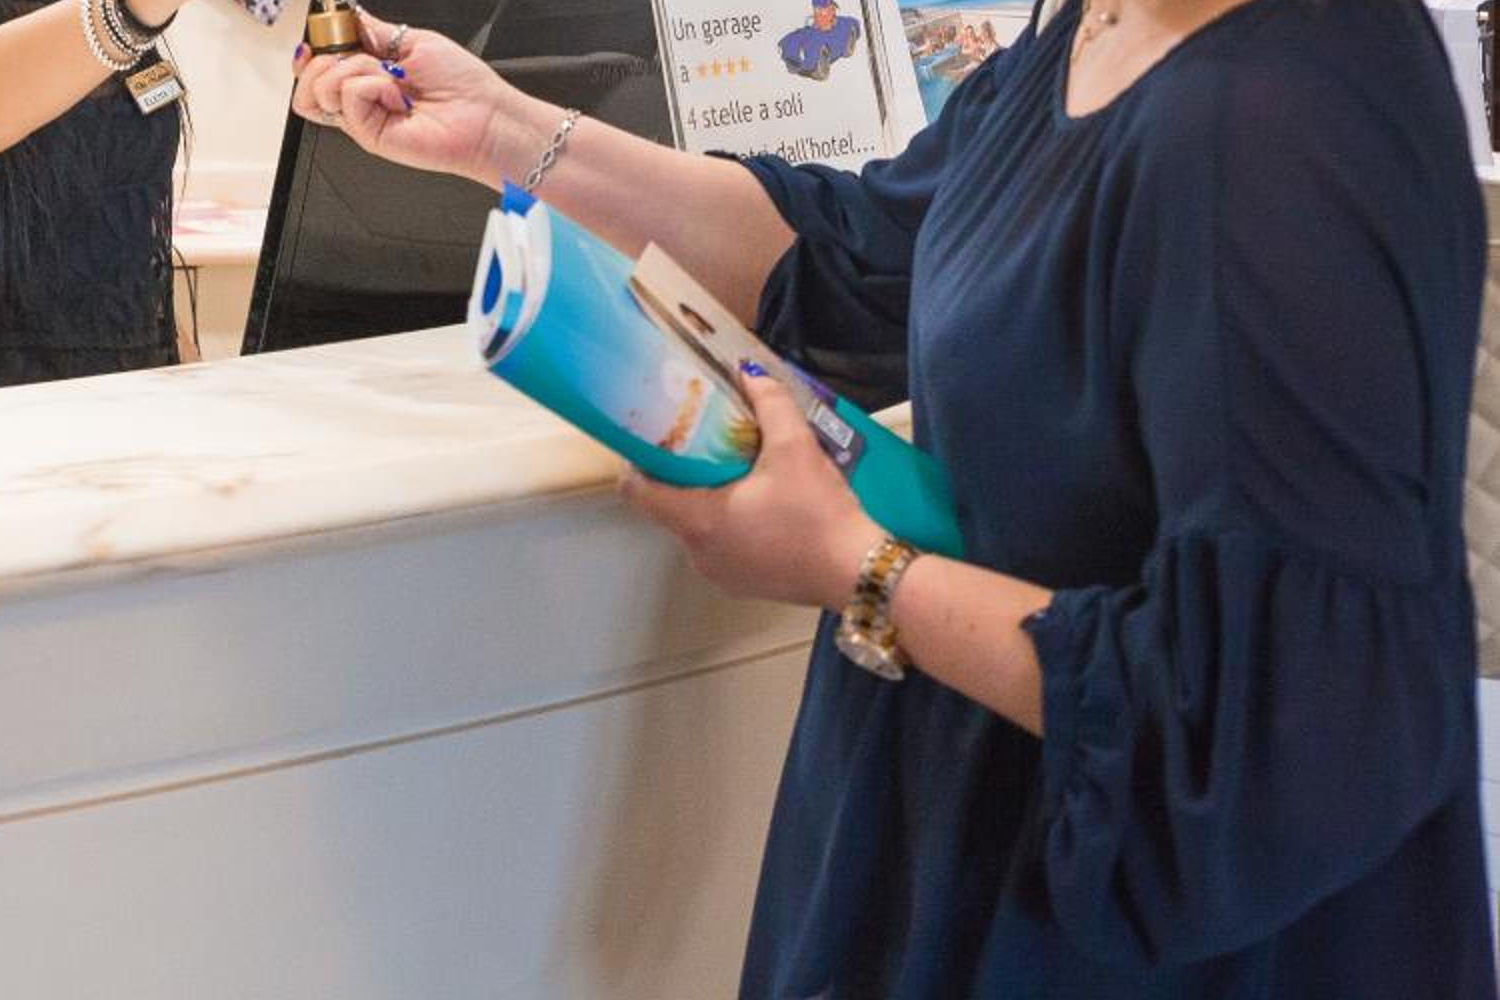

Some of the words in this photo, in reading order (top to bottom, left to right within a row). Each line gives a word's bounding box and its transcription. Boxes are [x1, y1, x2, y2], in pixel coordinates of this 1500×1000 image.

[672, 17, 697, 41] Un
[701, 14, 762, 45] garage
[687, 106, 697, 130] 4
[702, 99, 753, 129] stelle
[759, 102, 770, 121] a
[774, 91, 804, 119] soli
